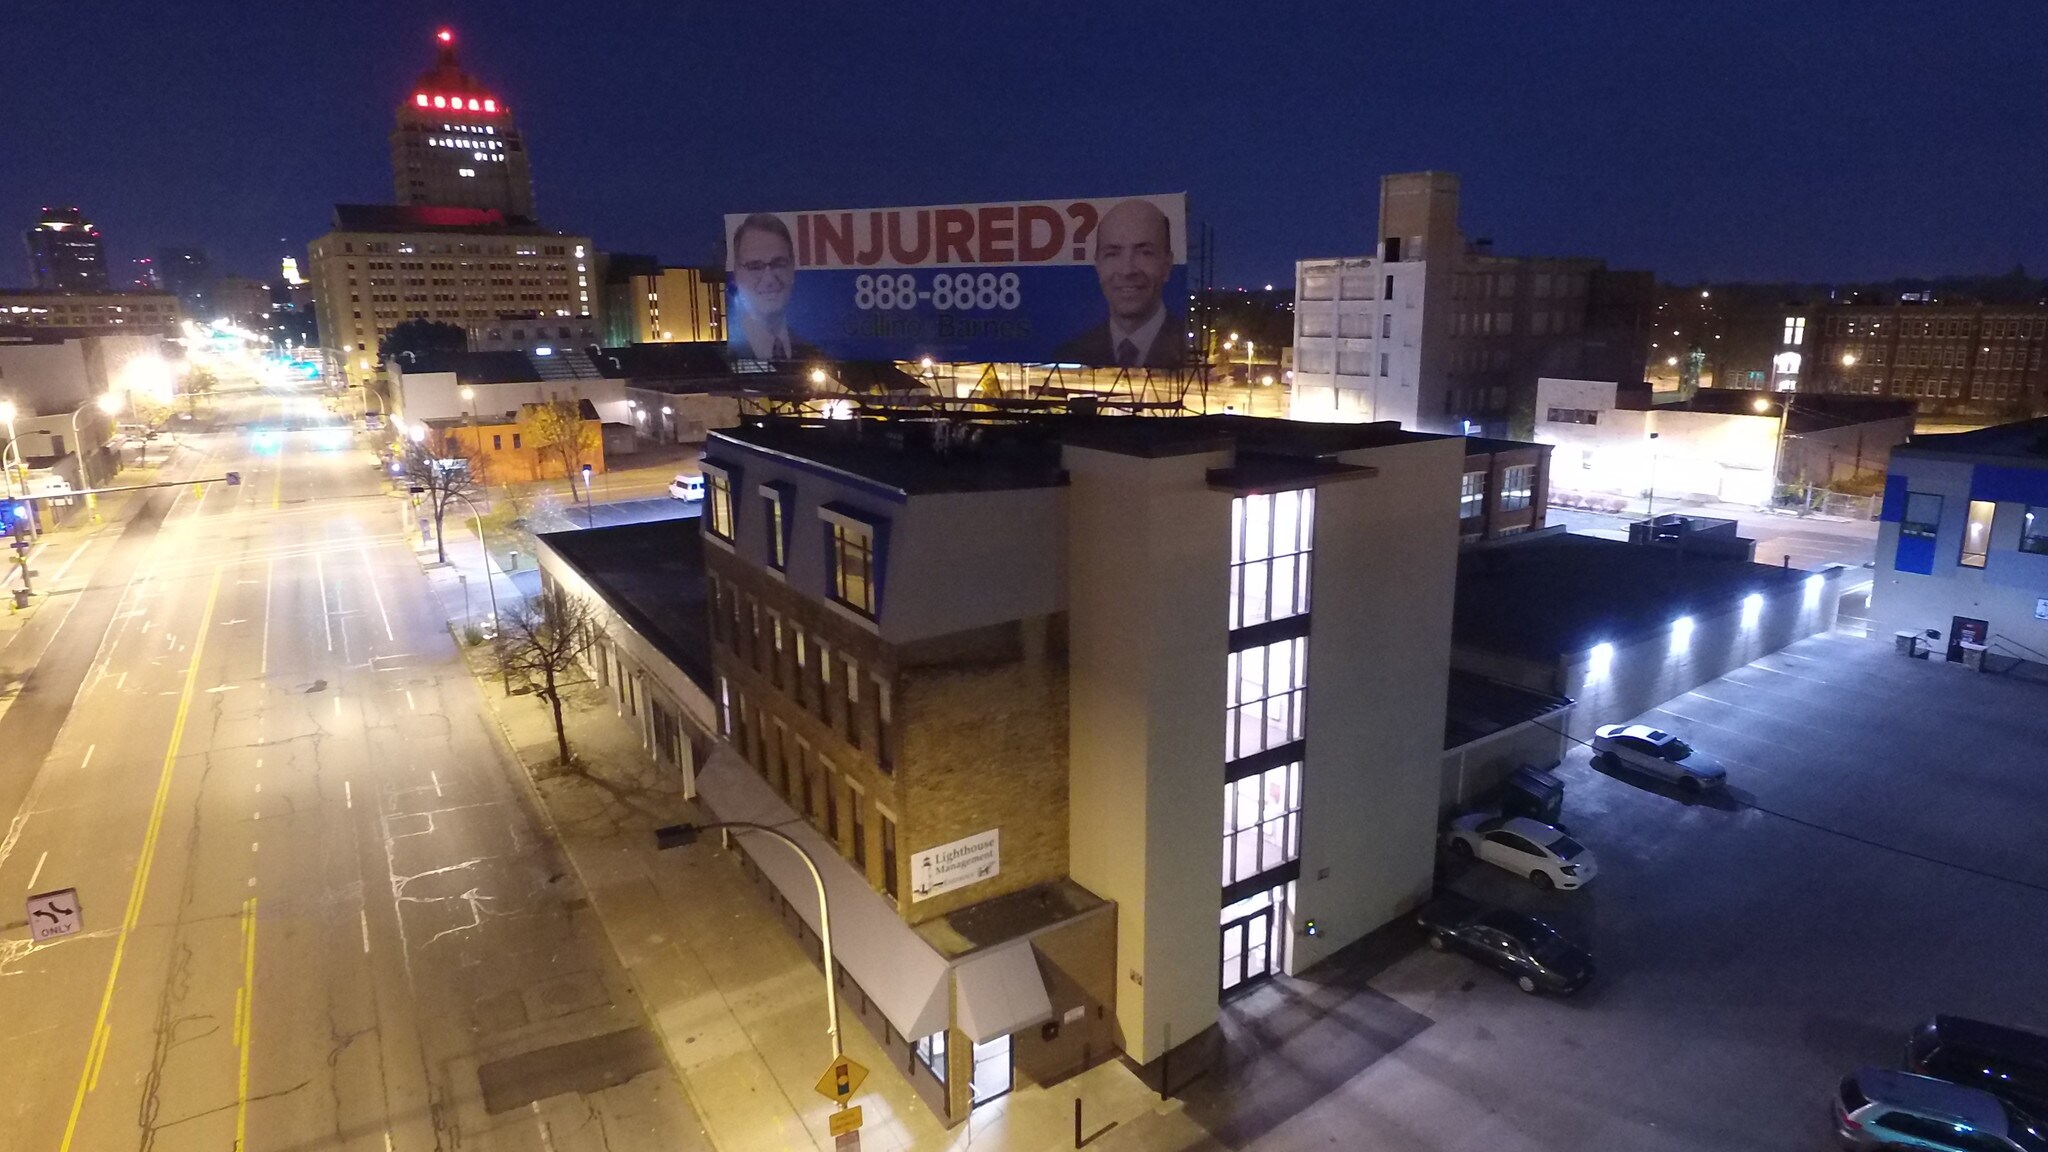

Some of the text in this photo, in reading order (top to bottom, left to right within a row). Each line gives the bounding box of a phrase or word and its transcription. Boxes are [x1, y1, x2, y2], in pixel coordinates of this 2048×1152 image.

[797, 202, 1098, 266] INJURED?
[855, 272, 1021, 311] 888-8888
[938, 314, 1031, 338] Barnes
[935, 839, 995, 865] Lighthouse
[935, 850, 994, 874] Management
[41, 923, 72, 937] ONLY
